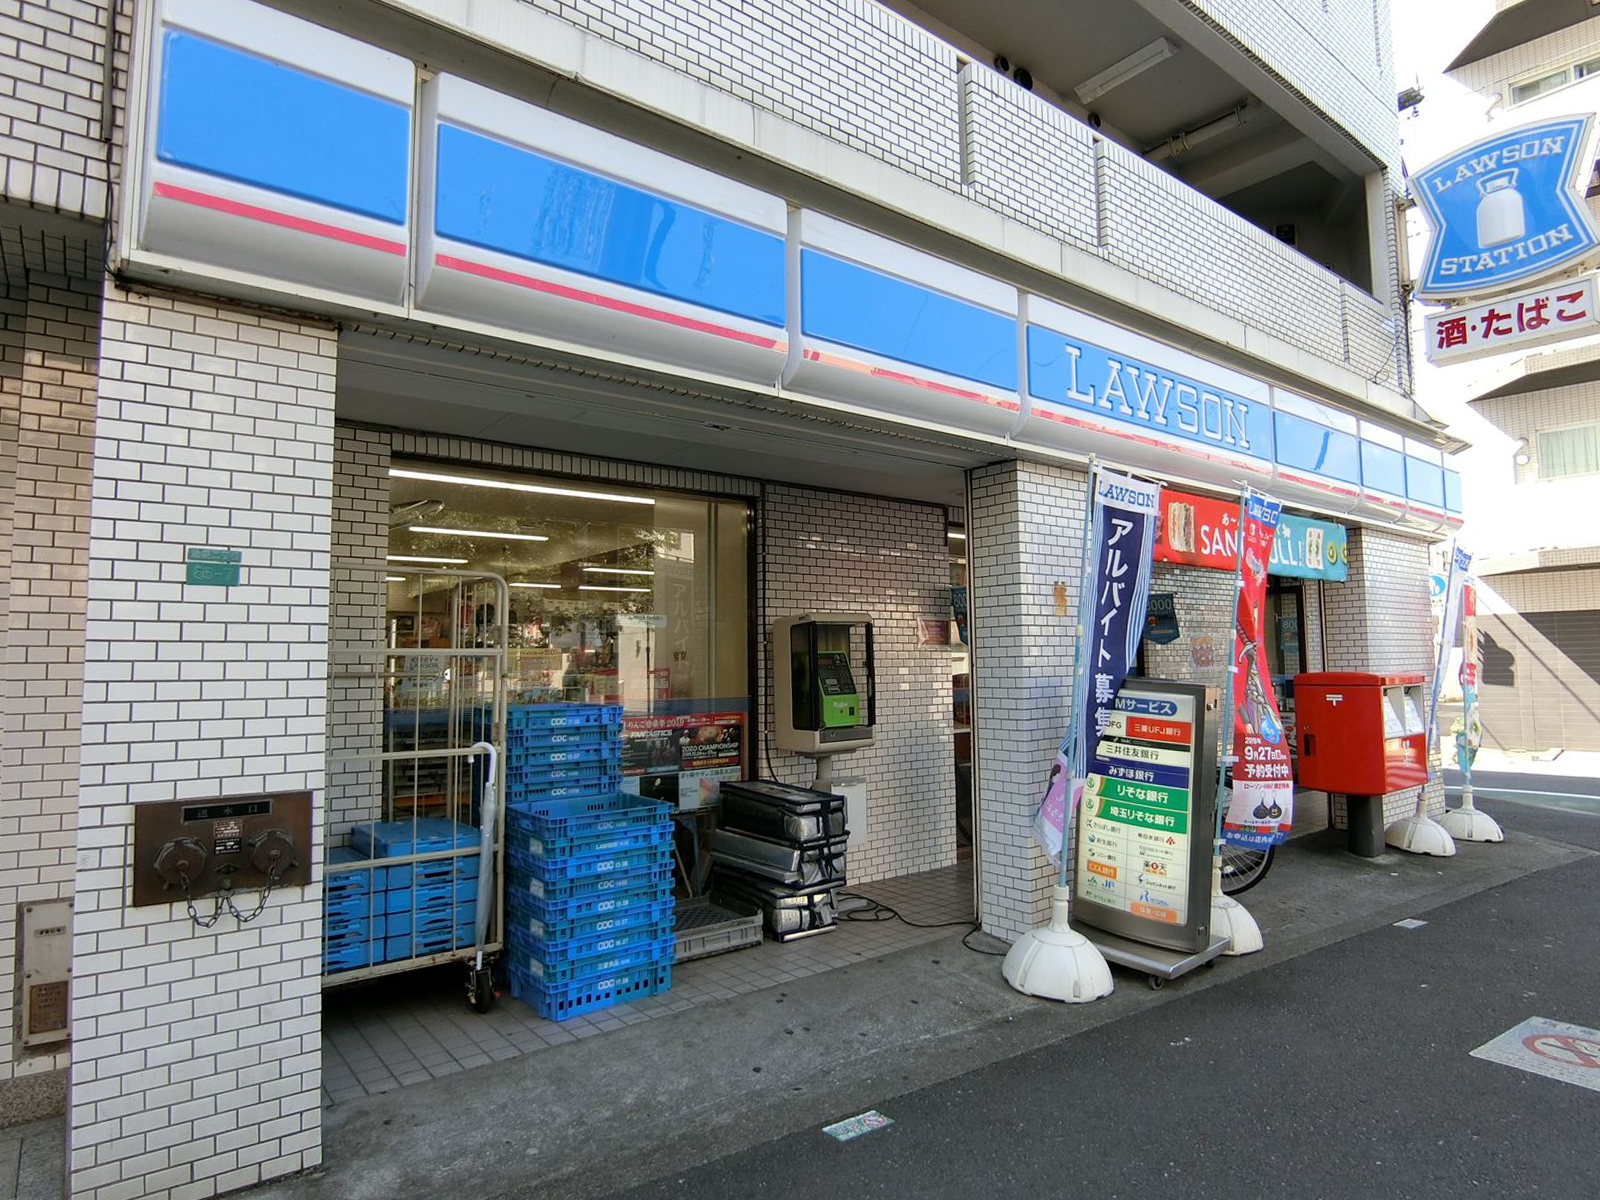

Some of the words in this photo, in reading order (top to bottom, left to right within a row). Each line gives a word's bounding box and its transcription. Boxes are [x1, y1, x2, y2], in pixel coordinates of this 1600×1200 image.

[1432, 135, 1566, 194] LAWSON
[1439, 223, 1574, 276] STATION
[1437, 290, 1587, 349] 酒・たばこ
[1064, 343, 1250, 449] LAWSON
[1098, 479, 1155, 509] LAWSON
[1093, 518, 1134, 738] アルバイト募集
[1114, 697, 1173, 715] Mサービス
[551, 735, 568, 743] CDC
[1105, 744, 1160, 760] 三井住友銀行
[551, 770, 567, 778] CDC
[1108, 765, 1155, 783] みずほ銀行
[1244, 763, 1289, 779] 予約受付中
[551, 788, 568, 796] CDC
[1117, 784, 1169, 804] りそな銀行
[1110, 805, 1175, 827] 埼玉りそな銀行
[597, 860, 615, 872] CDC
[598, 880, 615, 890] CDC
[598, 900, 615, 912] CDC
[597, 920, 614, 931] CDC
[598, 939, 615, 951] CDC
[598, 979, 615, 991] CDC
